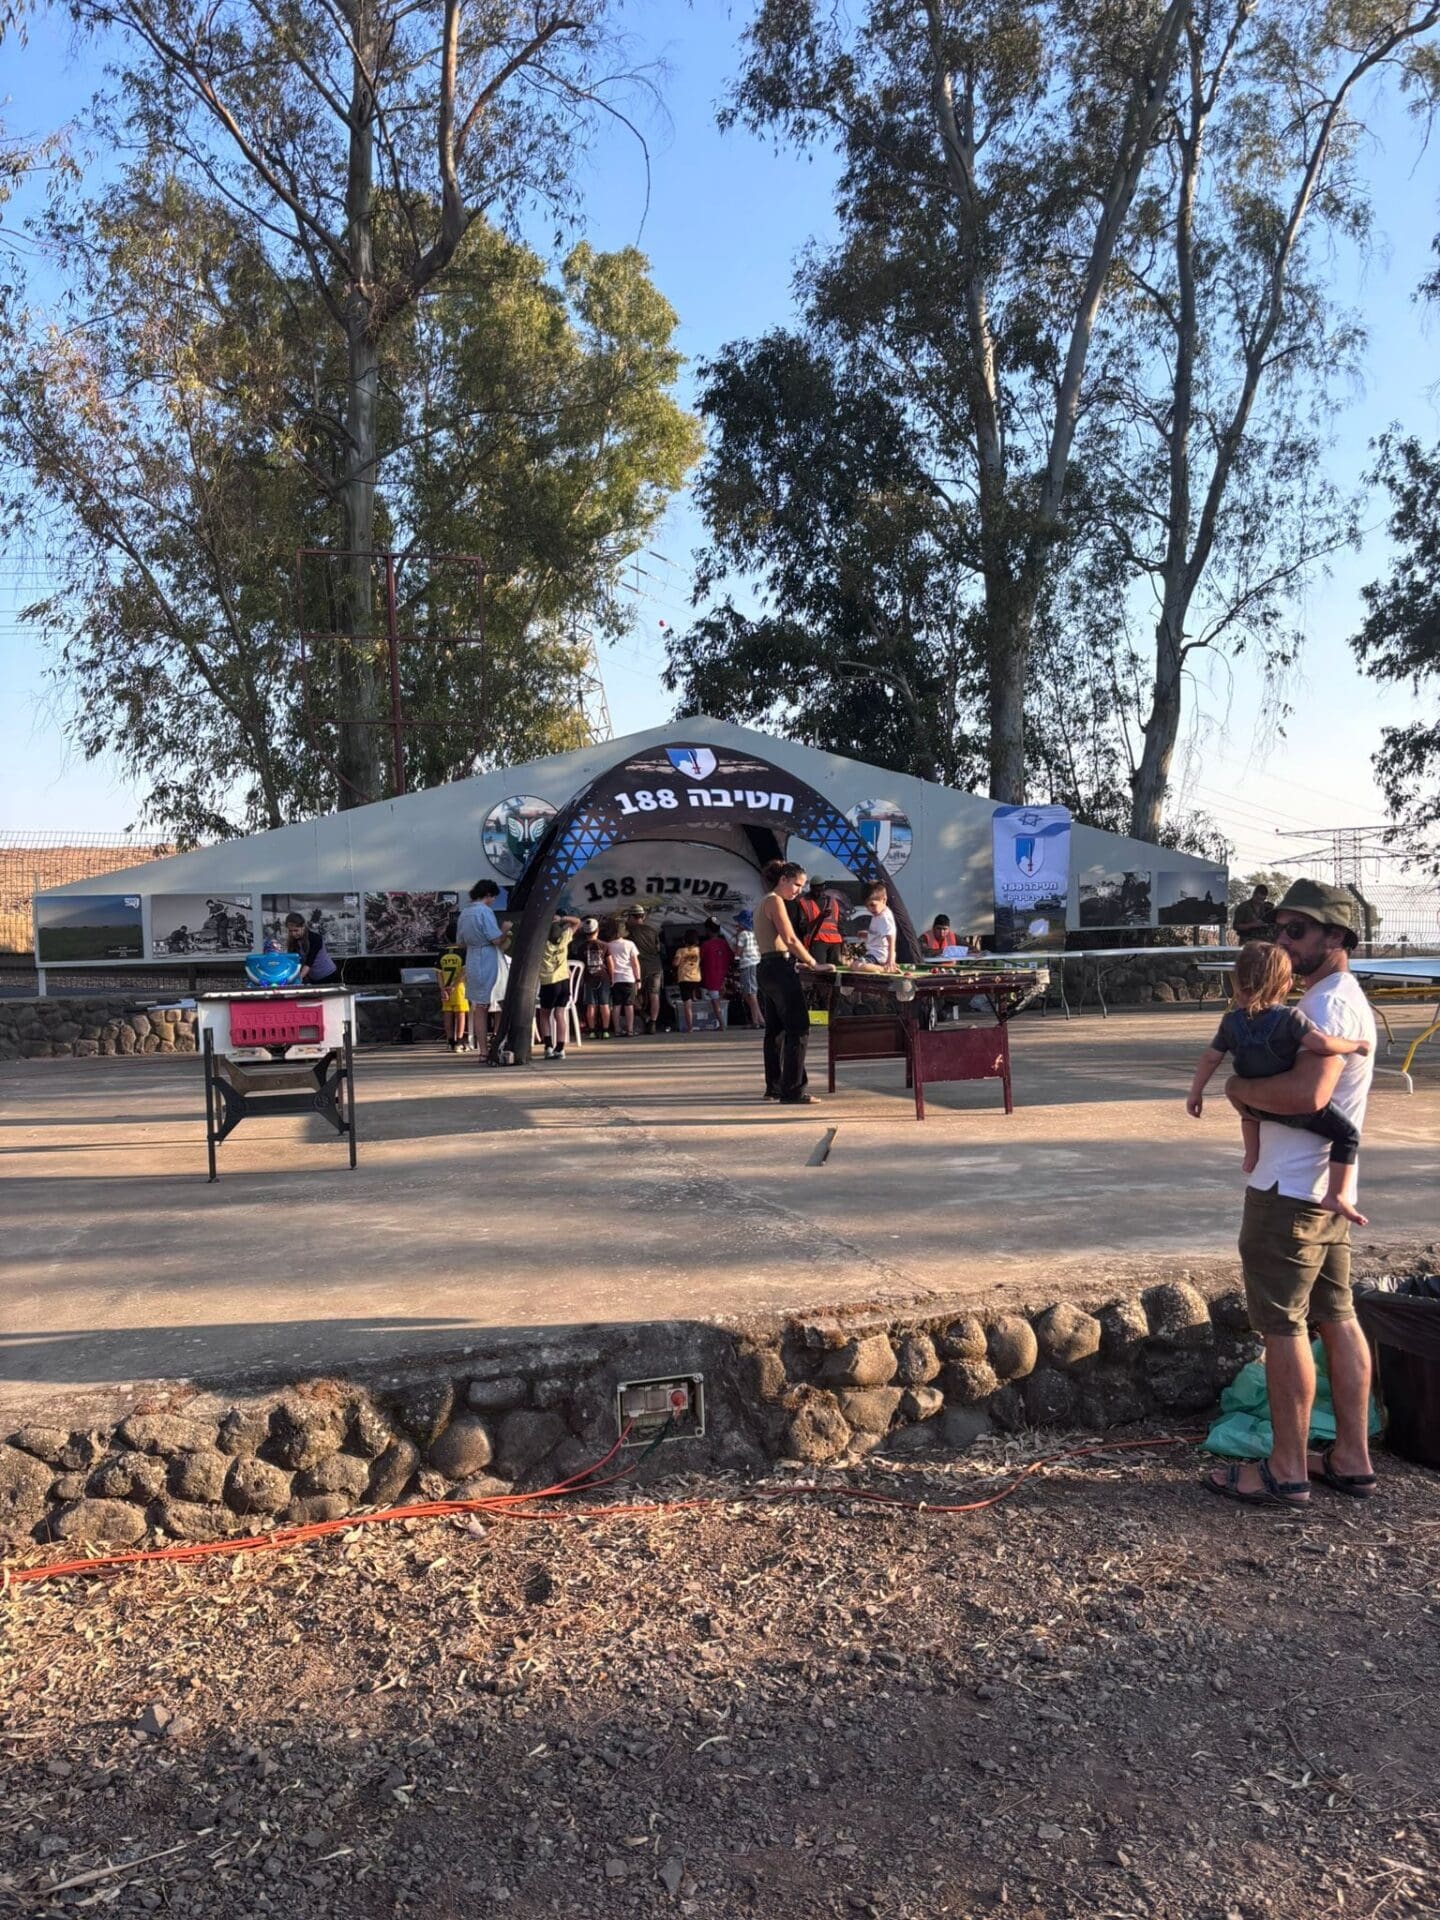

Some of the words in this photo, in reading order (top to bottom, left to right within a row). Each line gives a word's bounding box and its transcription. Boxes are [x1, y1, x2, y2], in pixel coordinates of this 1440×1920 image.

[614, 788, 678, 815] 188
[687, 788, 794, 814] חטיבה
[584, 876, 637, 902] 188
[646, 876, 729, 899] חטיבה
[1002, 883, 1024, 892] 188
[1025, 882, 1057, 891] חטיבה
[444, 967, 457, 987] 7
